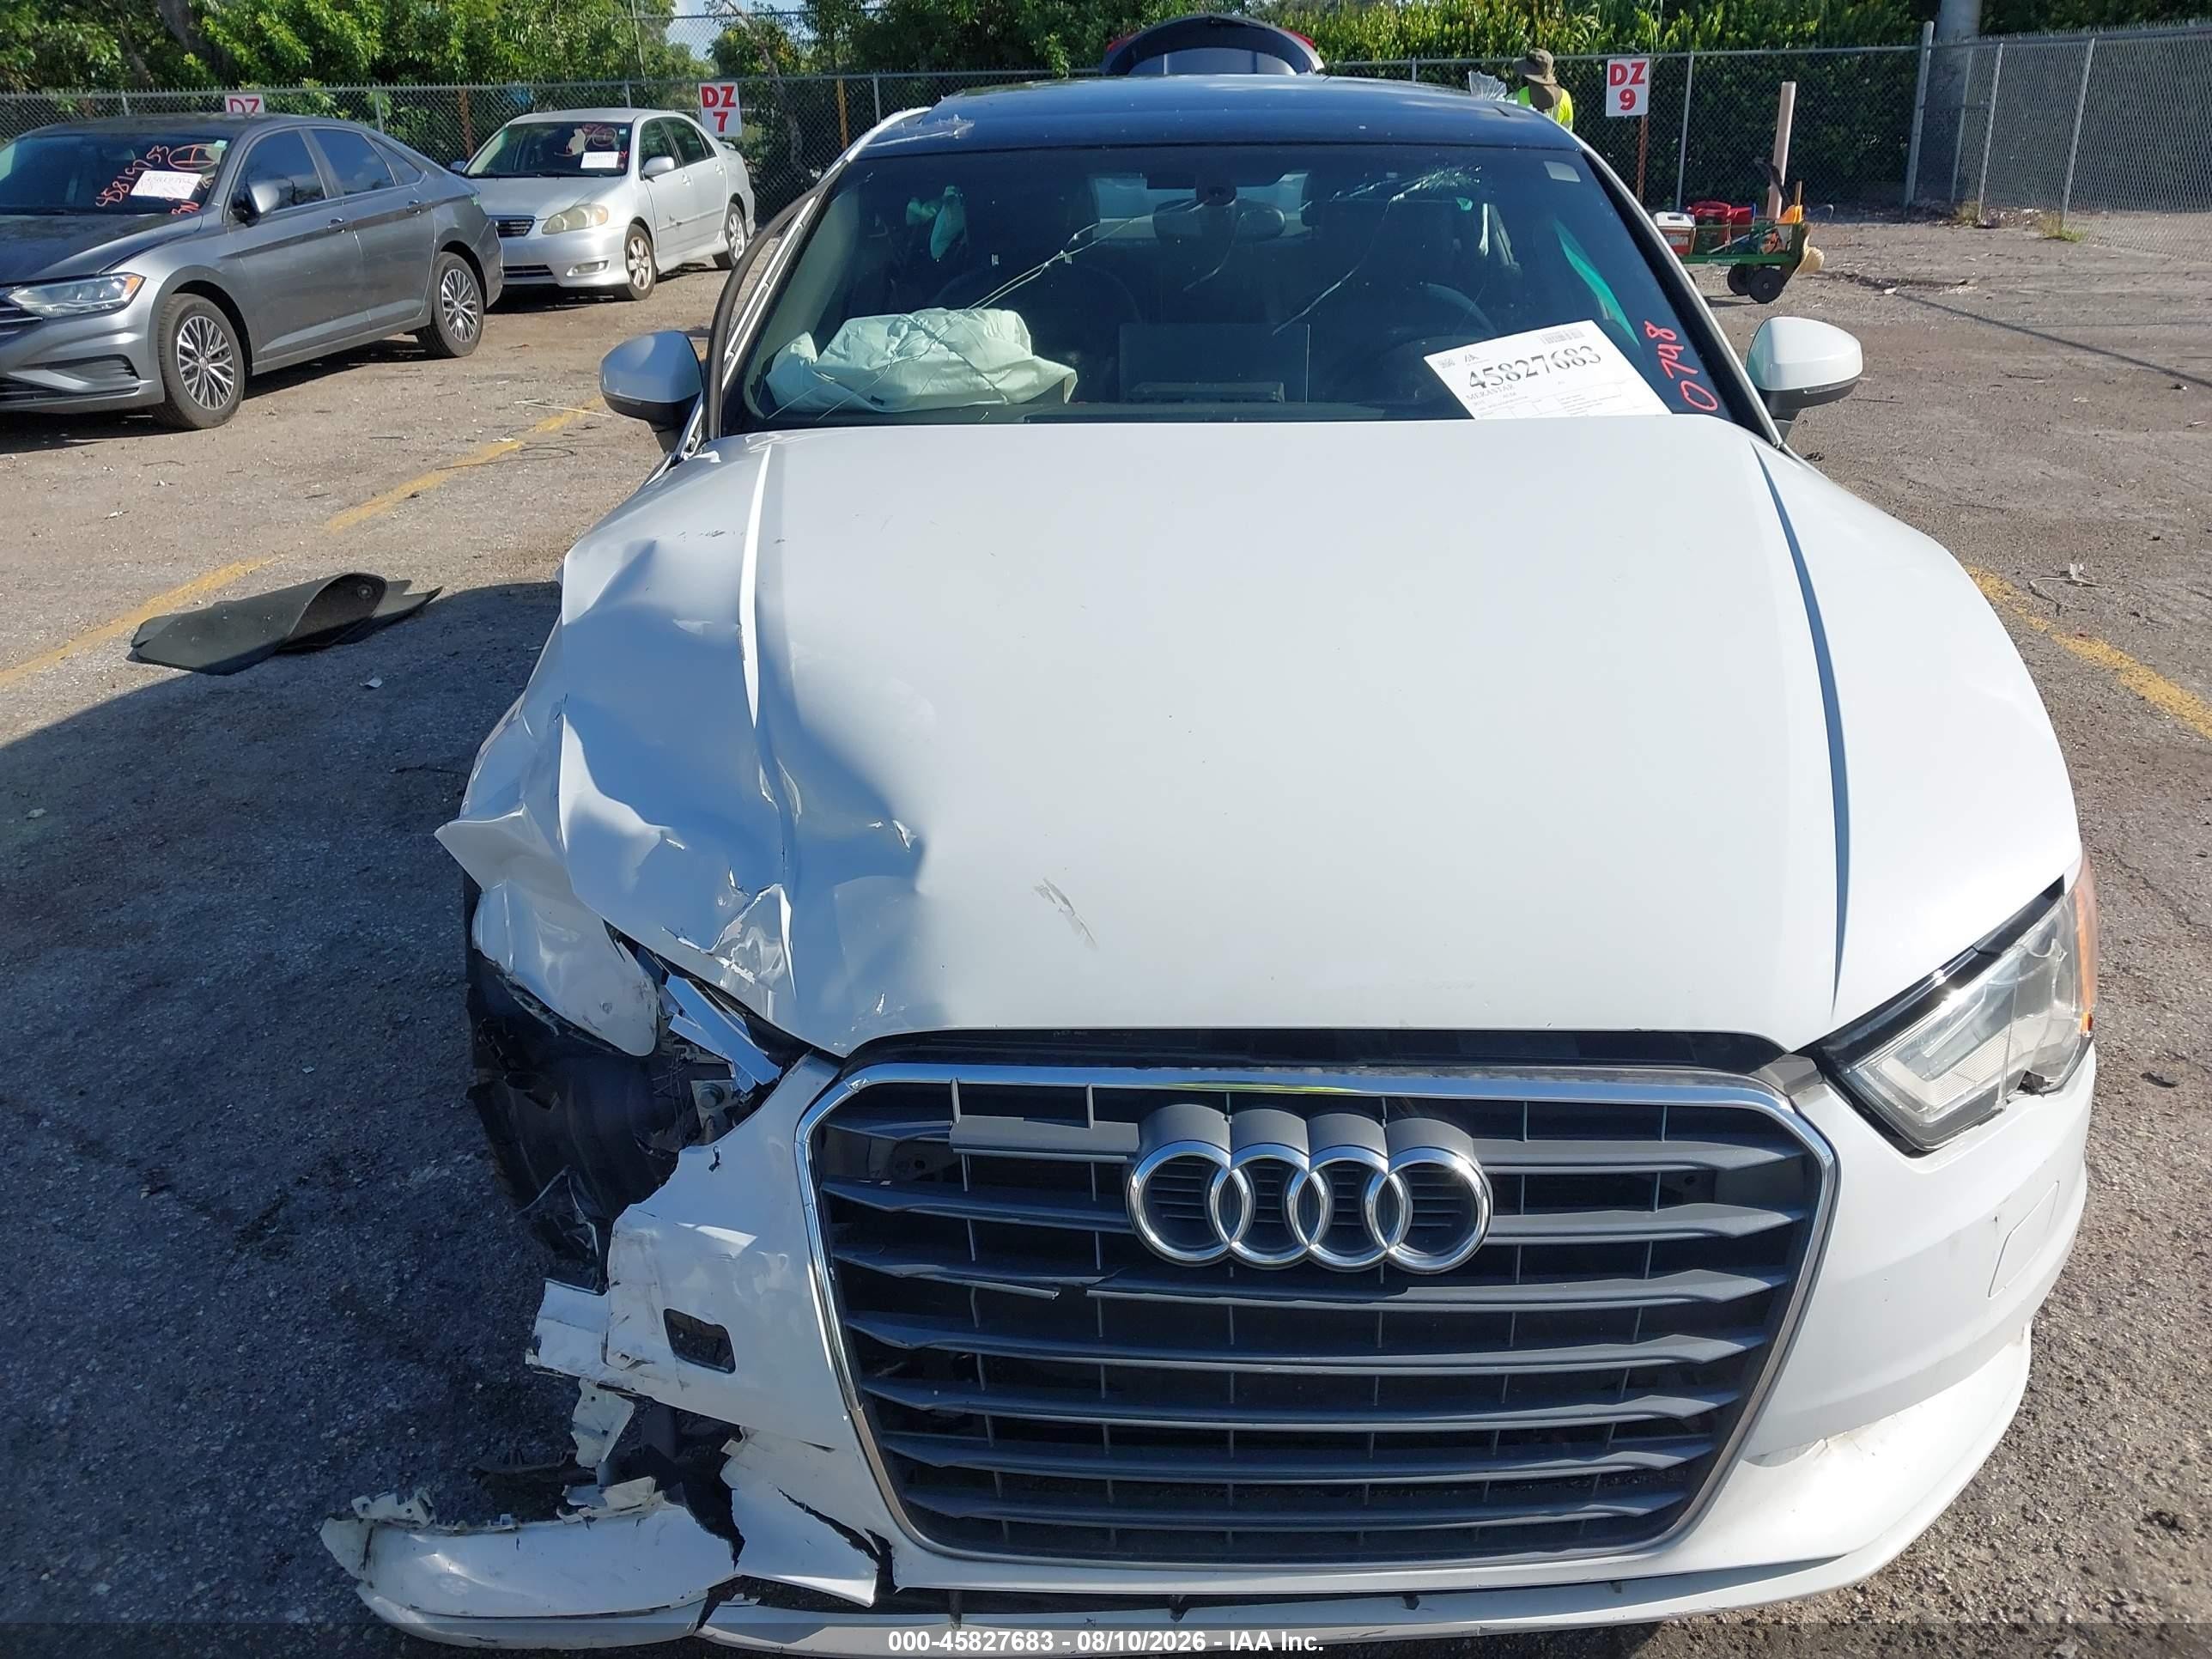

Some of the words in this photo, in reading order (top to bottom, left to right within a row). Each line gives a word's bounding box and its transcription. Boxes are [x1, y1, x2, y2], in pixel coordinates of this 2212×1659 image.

[1610, 62, 1646, 86] DZ
[701, 86, 736, 107] DZ
[1620, 88, 1636, 110] 9
[713, 111, 728, 132] 7
[1469, 345, 1601, 389] 45827683
[1644, 319, 1718, 412] 0748
